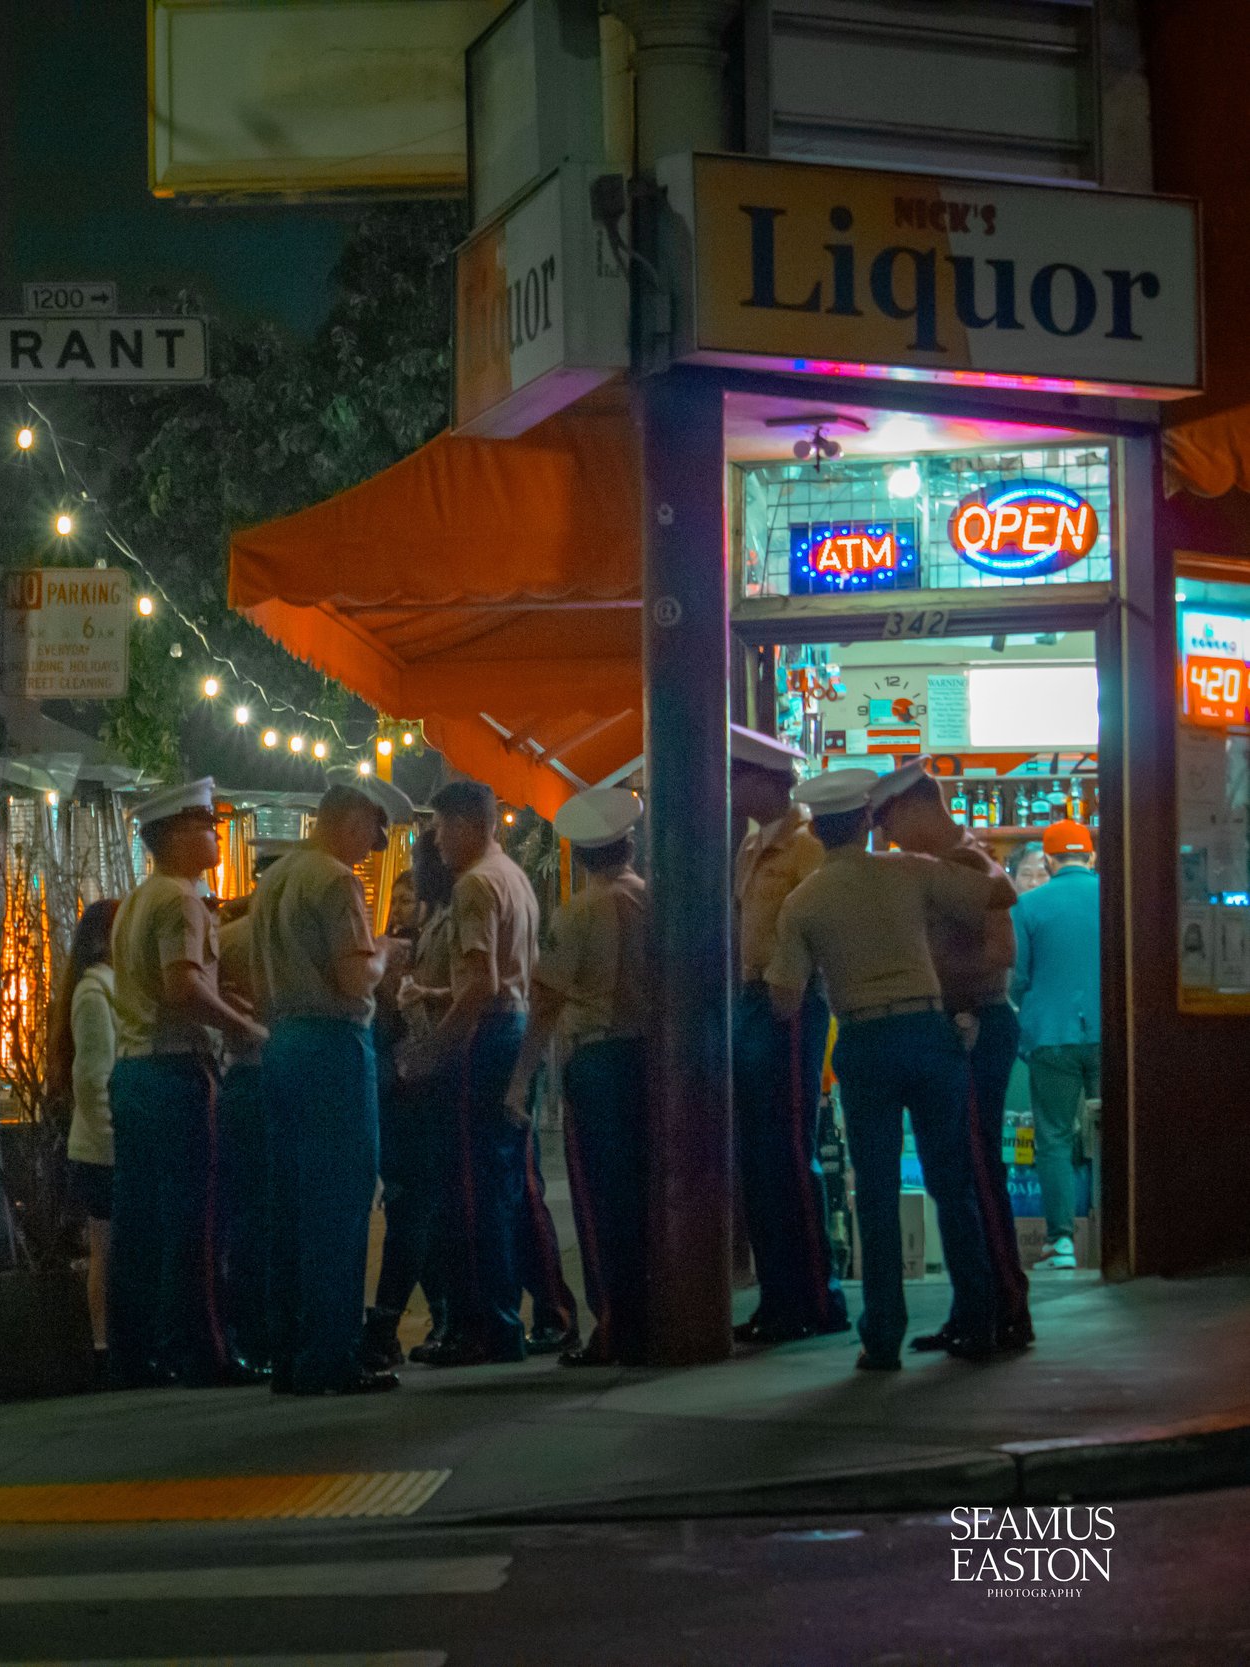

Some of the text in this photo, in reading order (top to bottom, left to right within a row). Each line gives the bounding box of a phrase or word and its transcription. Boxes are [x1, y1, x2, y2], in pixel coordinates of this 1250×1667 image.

[894, 196, 998, 236] NICK'S
[738, 203, 1161, 353] Liquor
[33, 289, 84, 309] 1200
[957, 505, 1088, 551] OPEN
[818, 536, 892, 571] ATM
[47, 582, 122, 606] PARKING
[82, 616, 95, 639] 6
[889, 610, 944, 637] 342
[884, 675, 901, 687] 12
[1190, 666, 1241, 703] 420
[857, 705, 869, 716] 9
